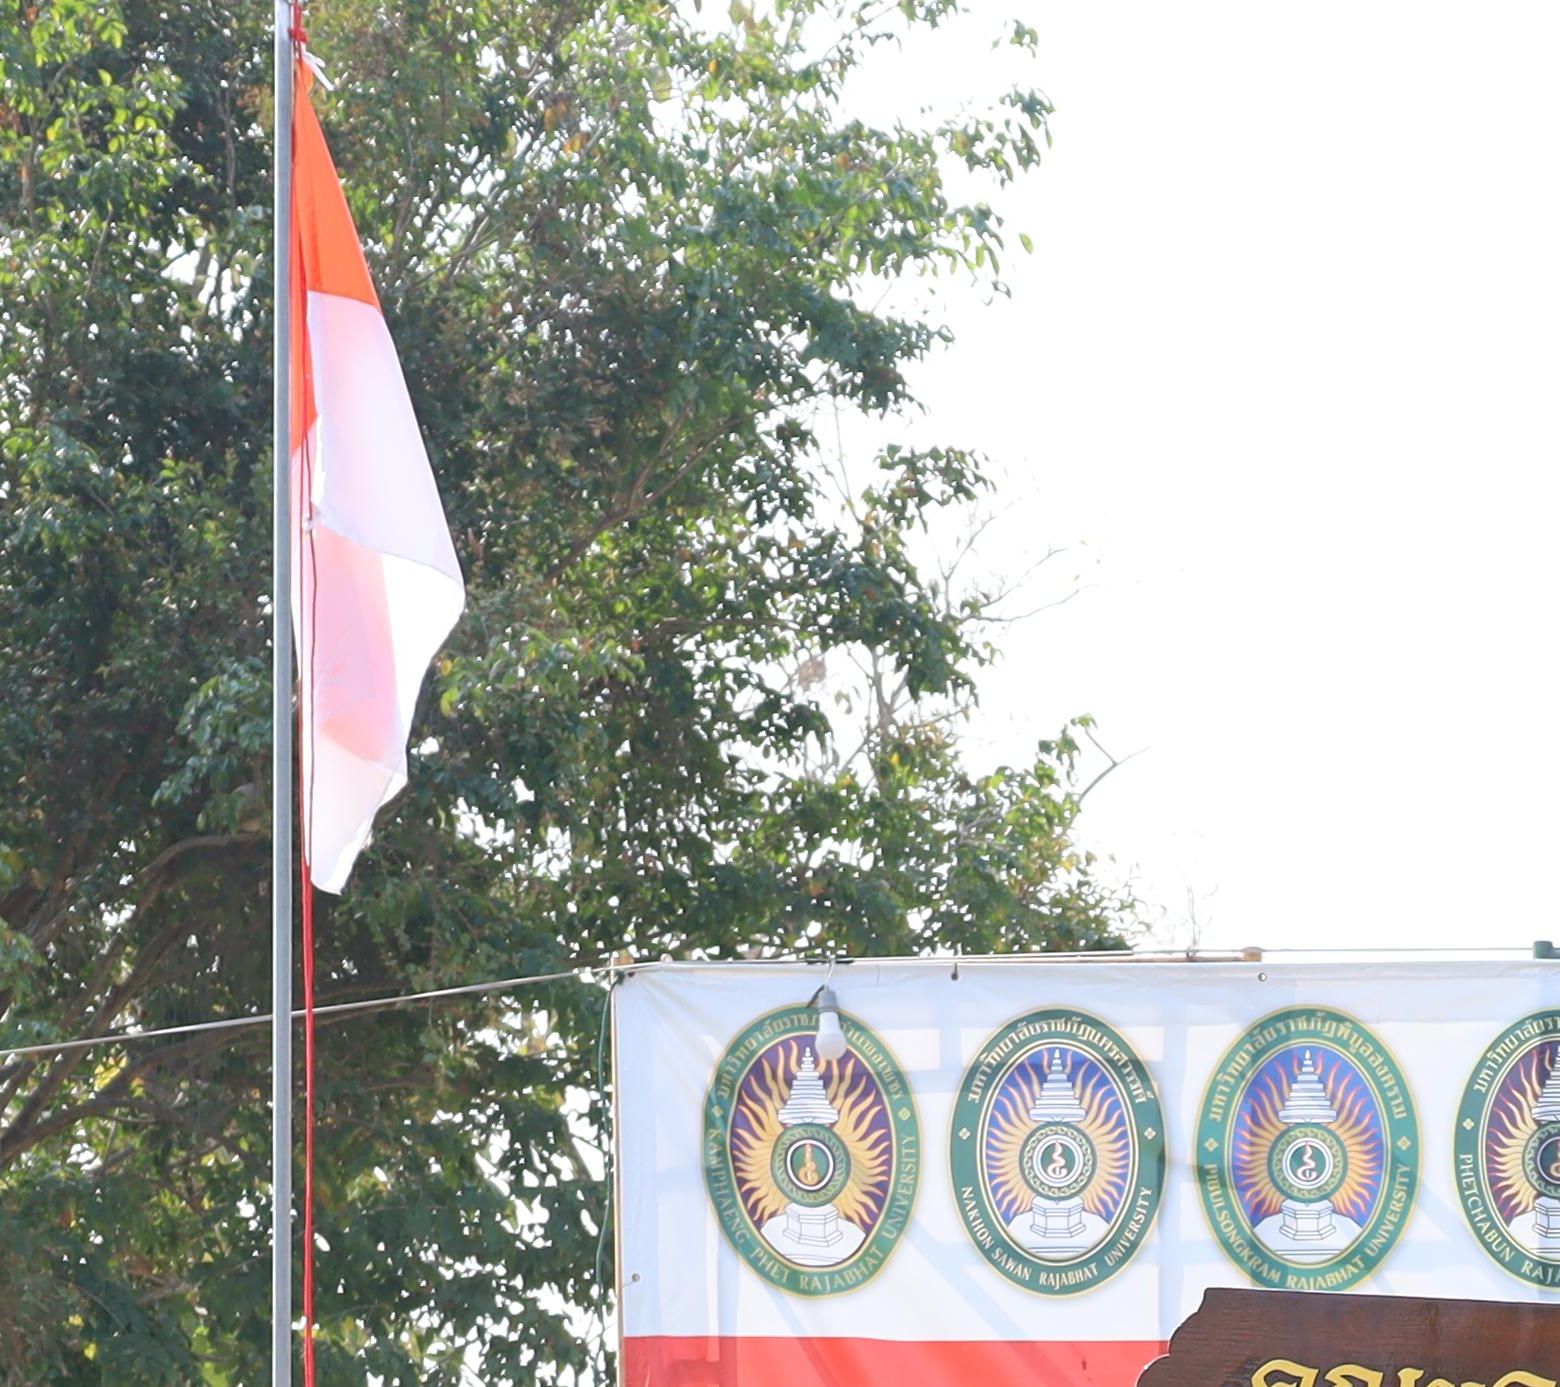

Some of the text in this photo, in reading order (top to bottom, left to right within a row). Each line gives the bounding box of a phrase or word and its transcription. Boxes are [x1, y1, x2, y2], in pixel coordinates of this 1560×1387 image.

[750, 1247, 790, 1284] PHET
[799, 1247, 884, 1293] RAJABHAT
[880, 1134, 918, 1241] UNIVERSITY
[962, 1186, 1153, 1290] NAKHON SAWAN RAJABHAT UNIVERSITY
[1286, 1255, 1366, 1291] RAJABHAT
[1368, 1163, 1411, 1257] UNIVERSITY
[1459, 1153, 1516, 1263] PHETCHABUN
